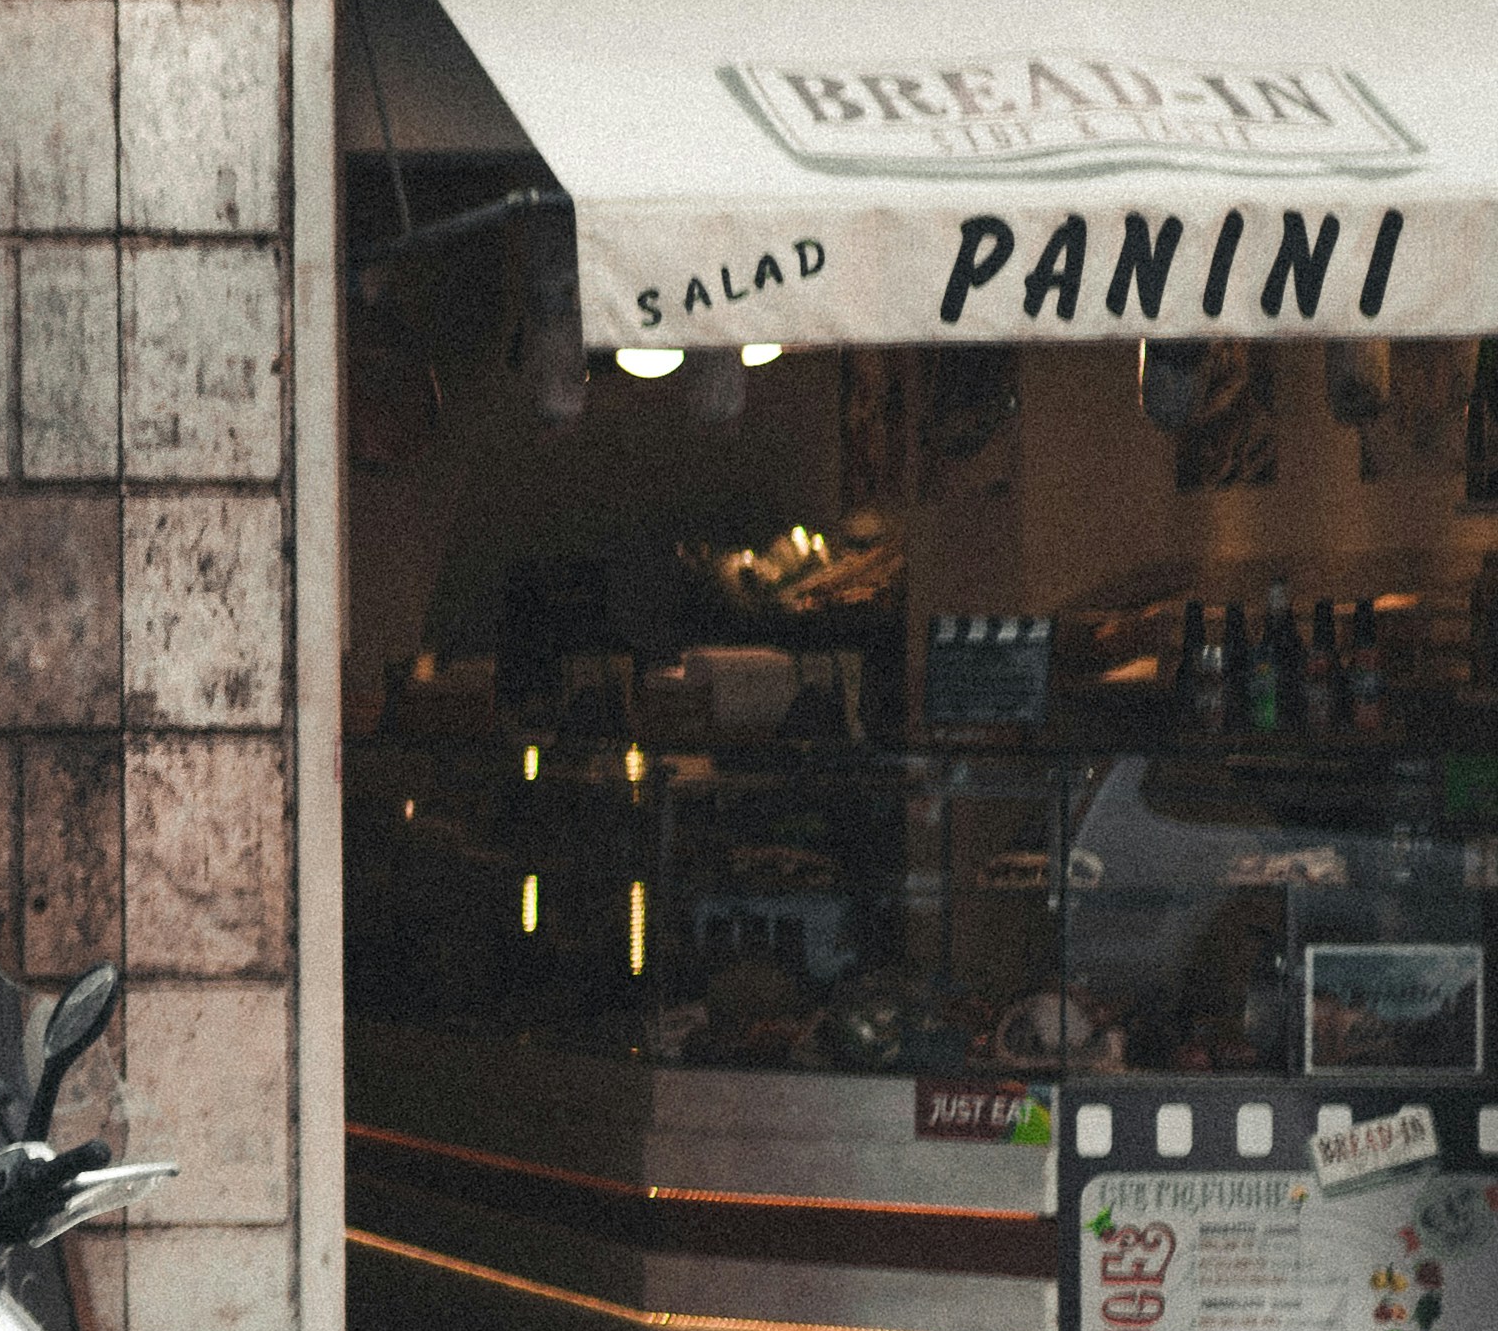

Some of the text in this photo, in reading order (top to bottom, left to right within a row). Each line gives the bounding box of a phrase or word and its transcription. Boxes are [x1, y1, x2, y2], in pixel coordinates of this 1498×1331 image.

[780, 58, 1334, 127] BREAD-IN
[637, 239, 826, 328] SALAD
[940, 208, 1404, 324] PANINI
[927, 1092, 1033, 1127] JUST EAT
